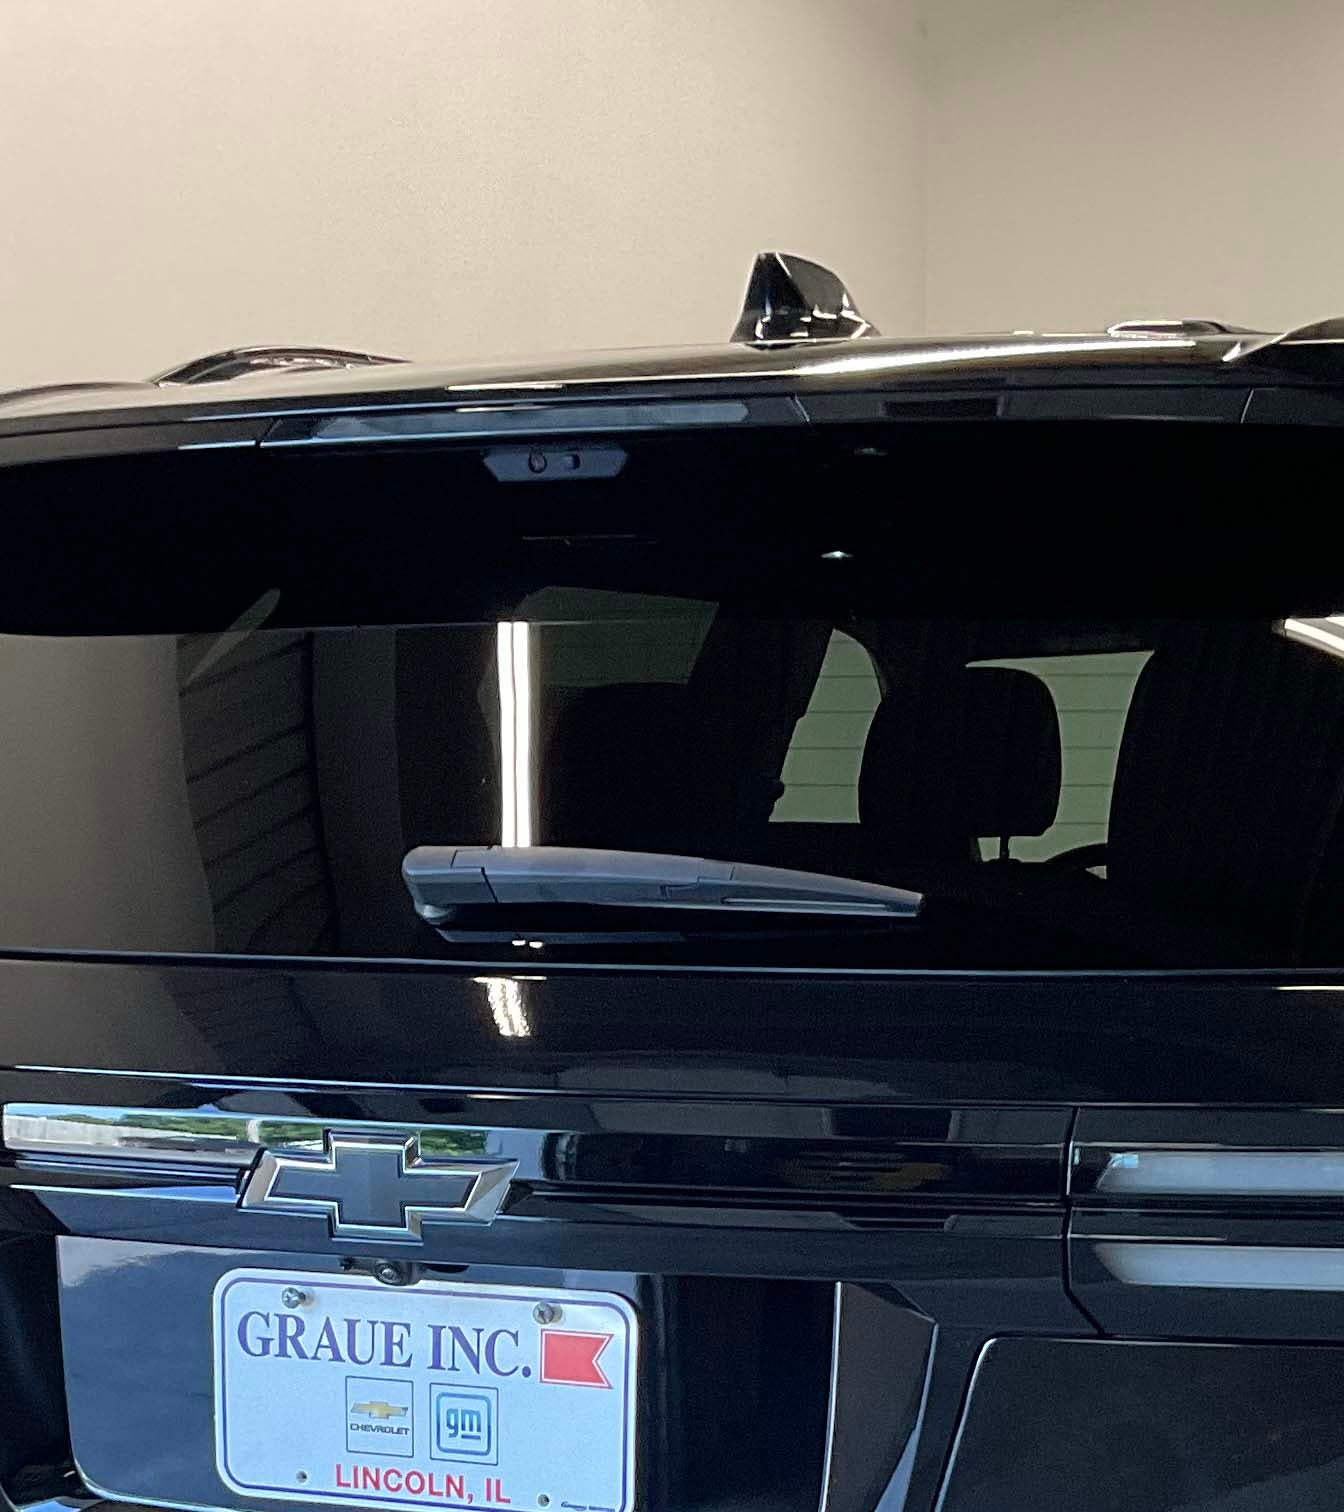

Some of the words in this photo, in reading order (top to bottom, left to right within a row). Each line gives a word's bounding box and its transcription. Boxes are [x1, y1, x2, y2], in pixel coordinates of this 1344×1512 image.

[238, 1310, 413, 1368] GRAUE
[427, 1324, 532, 1378] INC.
[349, 1422, 411, 1437] CHEVROLET
[335, 1464, 474, 1504] LINCOLN,
[485, 1477, 512, 1504] IL
